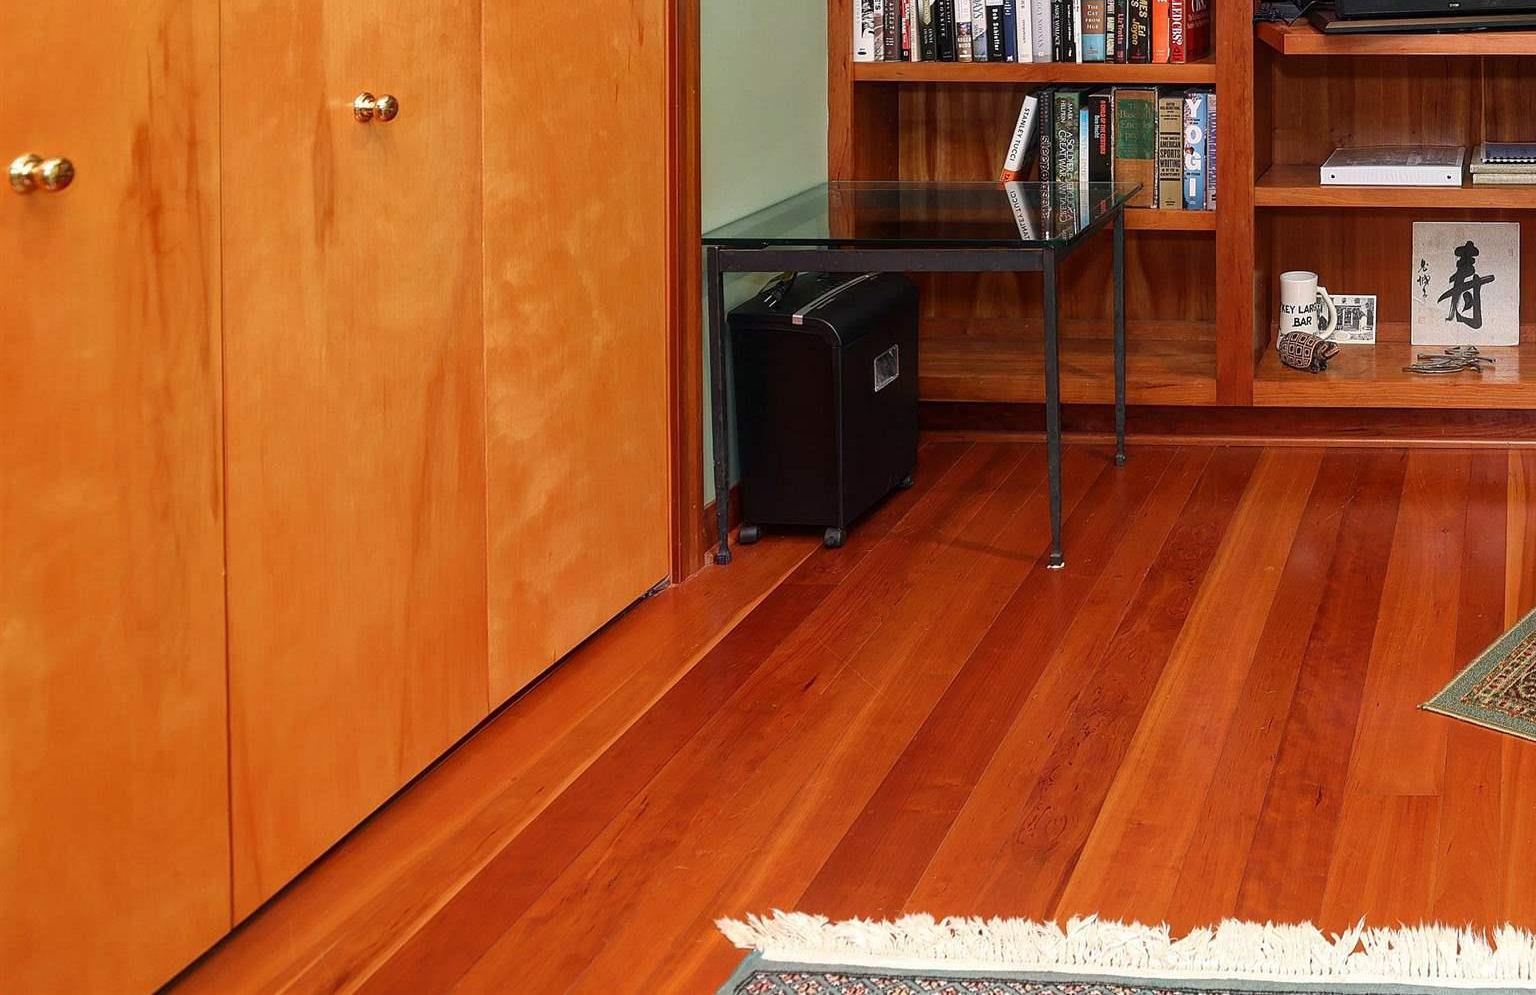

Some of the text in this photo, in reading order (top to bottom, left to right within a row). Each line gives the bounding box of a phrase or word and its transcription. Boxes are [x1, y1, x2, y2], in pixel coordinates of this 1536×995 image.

[1107, 17, 1115, 32] HARRY
[1117, 24, 1125, 45] Trotta
[1131, 18, 1139, 45] Joyce
[1138, 25, 1146, 37] Ed
[1171, 21, 1183, 46] CBS?
[1107, 33, 1115, 55] REASONER
[1010, 108, 1030, 161] STANLEY TUCCI
[1058, 130, 1067, 177] GREAT WAR
[1066, 139, 1075, 173] SOLDIER
[1160, 149, 1181, 159] SPORTS
[1185, 99, 1202, 197] YOGI
[1160, 159, 1181, 168] WRITING
[1281, 305, 1296, 314] KEY
[1293, 317, 1312, 327] BAR
